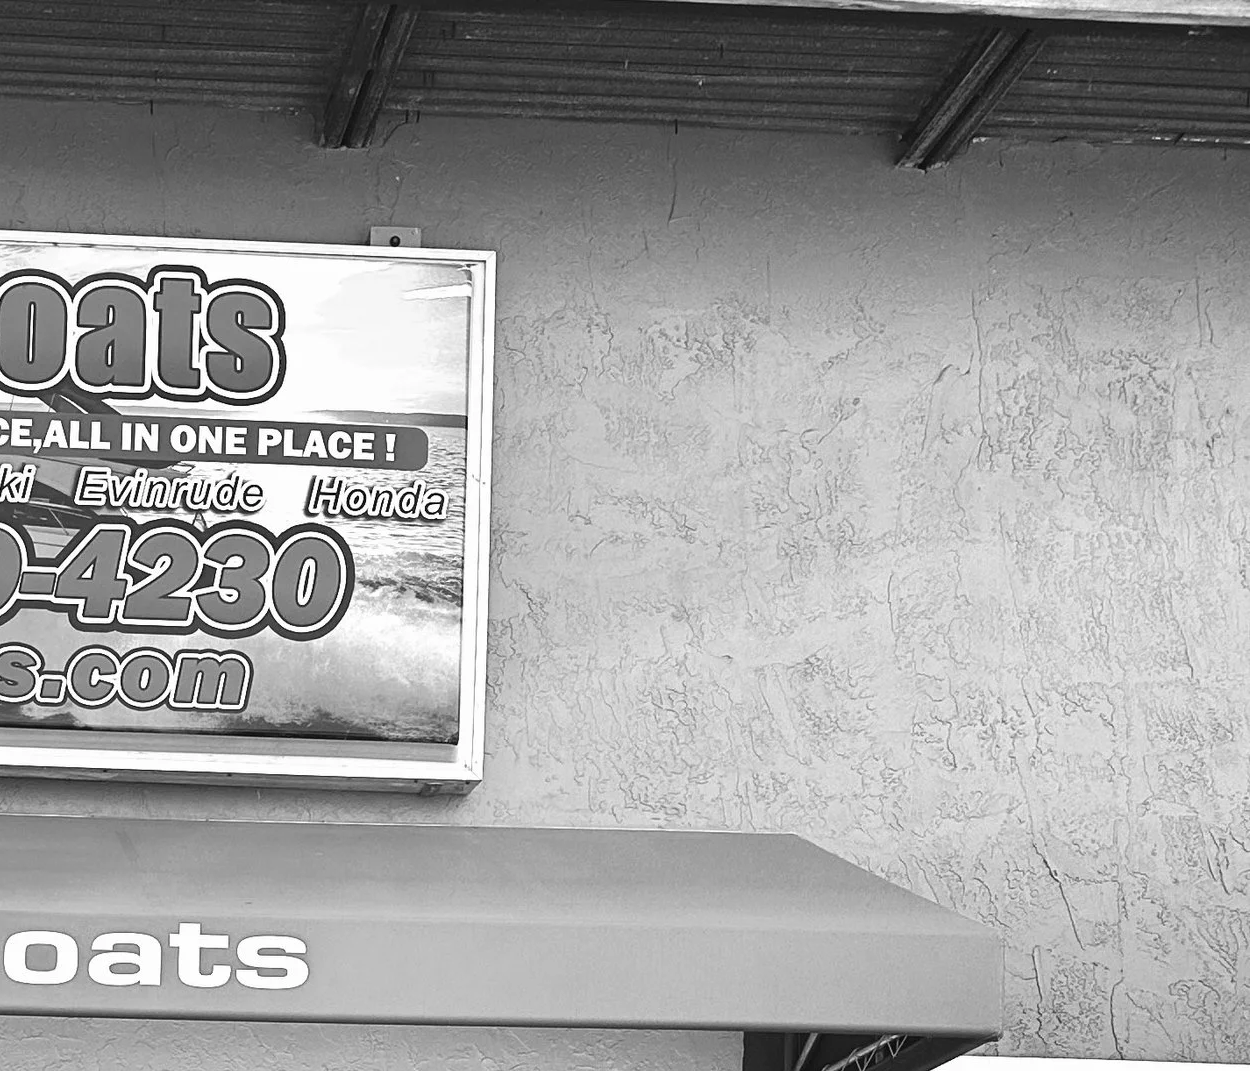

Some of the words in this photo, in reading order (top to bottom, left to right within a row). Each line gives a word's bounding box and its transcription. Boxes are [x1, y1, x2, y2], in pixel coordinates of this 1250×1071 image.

[121, 422, 159, 453] IN
[170, 424, 248, 455] ONE
[257, 428, 375, 461] PLACE
[74, 465, 267, 512] Evinrude
[306, 474, 450, 519] Honda
